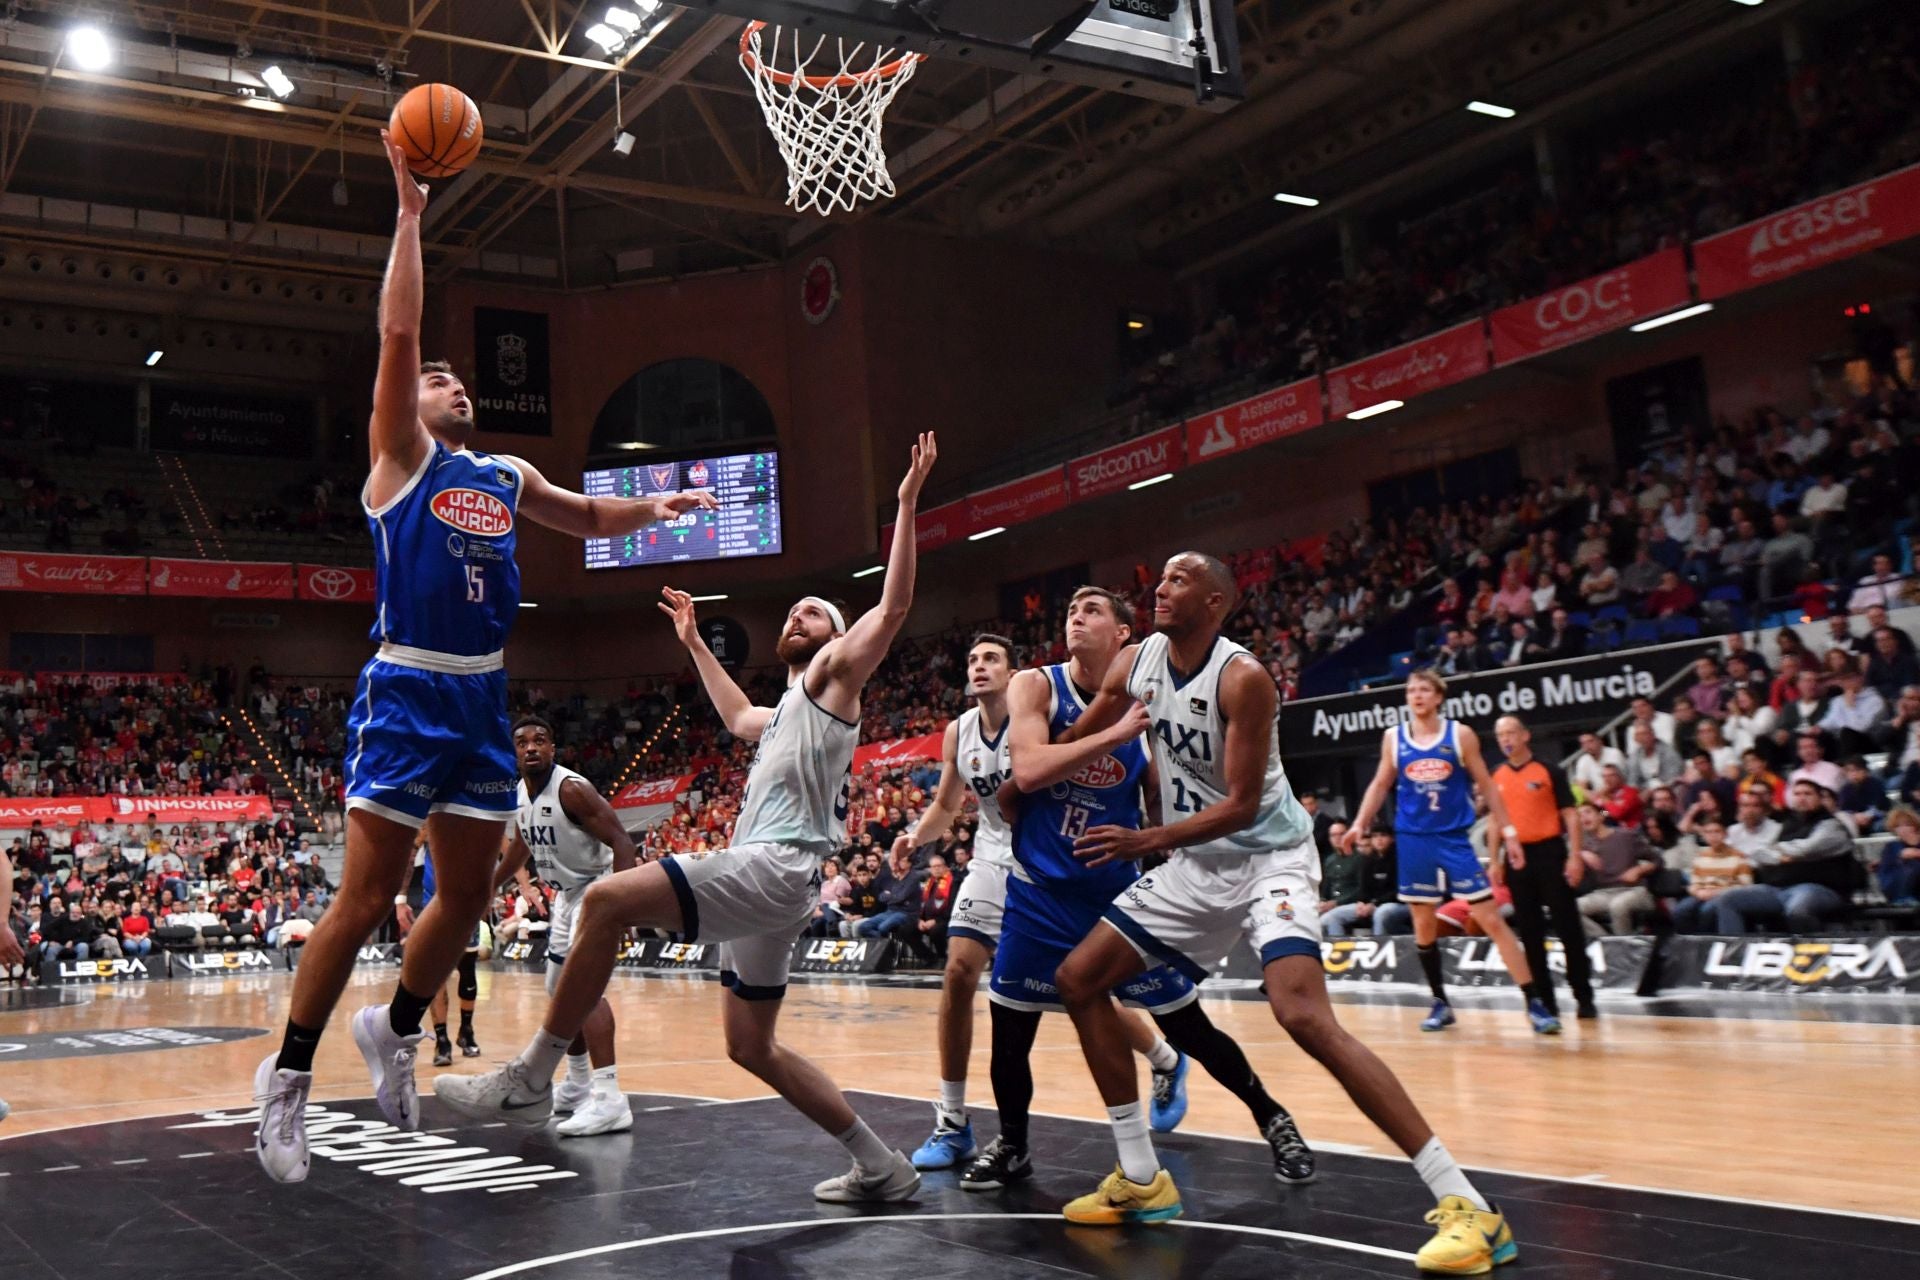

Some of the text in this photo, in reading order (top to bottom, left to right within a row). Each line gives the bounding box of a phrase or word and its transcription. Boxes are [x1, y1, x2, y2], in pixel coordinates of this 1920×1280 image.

[1768, 188, 1876, 247] caser
[169, 402, 286, 424] Ayuntamiento
[478, 398, 547, 414] MURCIA
[1239, 393, 1297, 423] Asterra
[1239, 410, 1308, 446] Partners
[1076, 439, 1170, 488] setcomur
[450, 493, 502, 516] UCAM
[439, 506, 508, 532] MURCIA
[464, 564, 485, 603] 15
[1498, 685, 1537, 711] de
[1543, 665, 1656, 707] Murcia
[21, 805, 84, 816] VITAE
[1426, 791, 1441, 811] 2
[1060, 803, 1090, 839] 13
[59, 957, 147, 977] LIBERA
[188, 950, 272, 969] LIBERA
[1703, 935, 1909, 985] LIBERA
